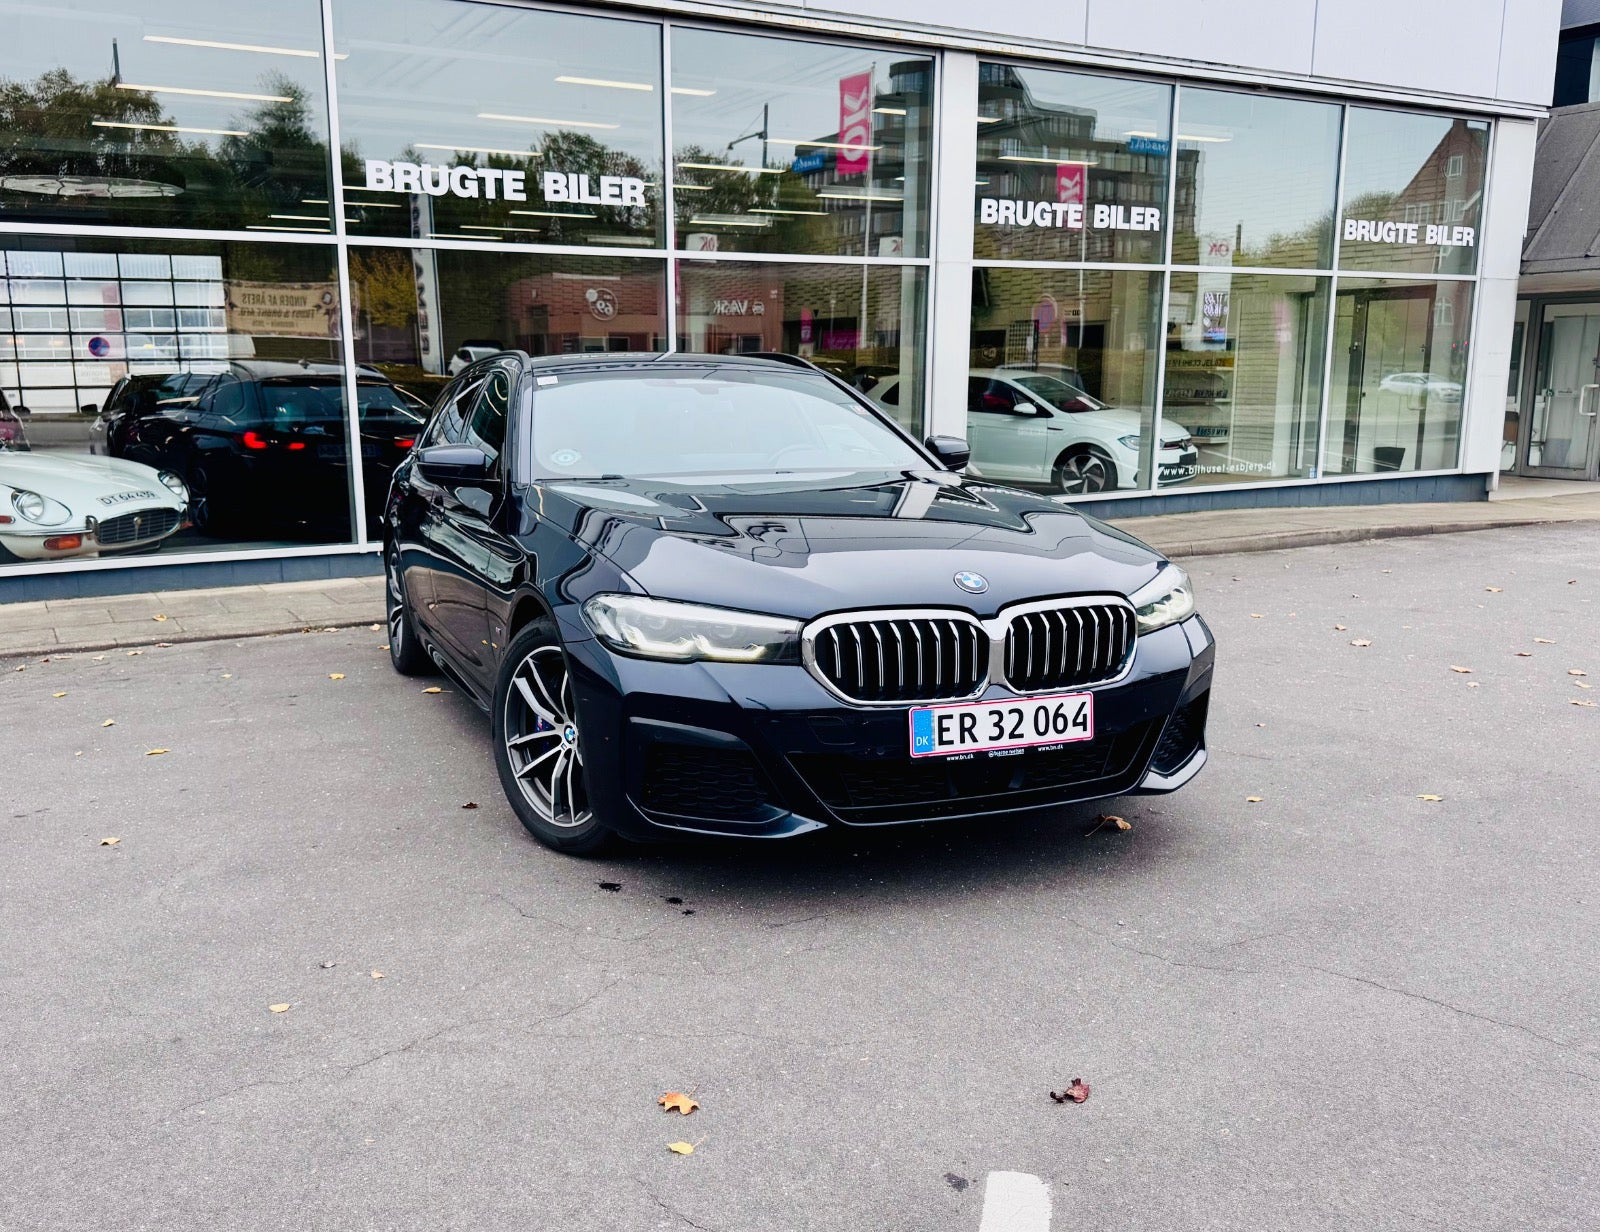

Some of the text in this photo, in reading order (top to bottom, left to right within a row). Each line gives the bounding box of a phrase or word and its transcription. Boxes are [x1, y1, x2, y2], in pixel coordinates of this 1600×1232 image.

[365, 160, 646, 207] BRUGTE BILER
[980, 198, 1160, 231] BRUGTE BILER
[1344, 219, 1475, 247] BRUGTE BILER
[937, 701, 1088, 747] ER 32 064
[916, 735, 929, 747] DK
[1038, 744, 1064, 752] www.bn.dk
[946, 753, 974, 761] www.bn.dk
